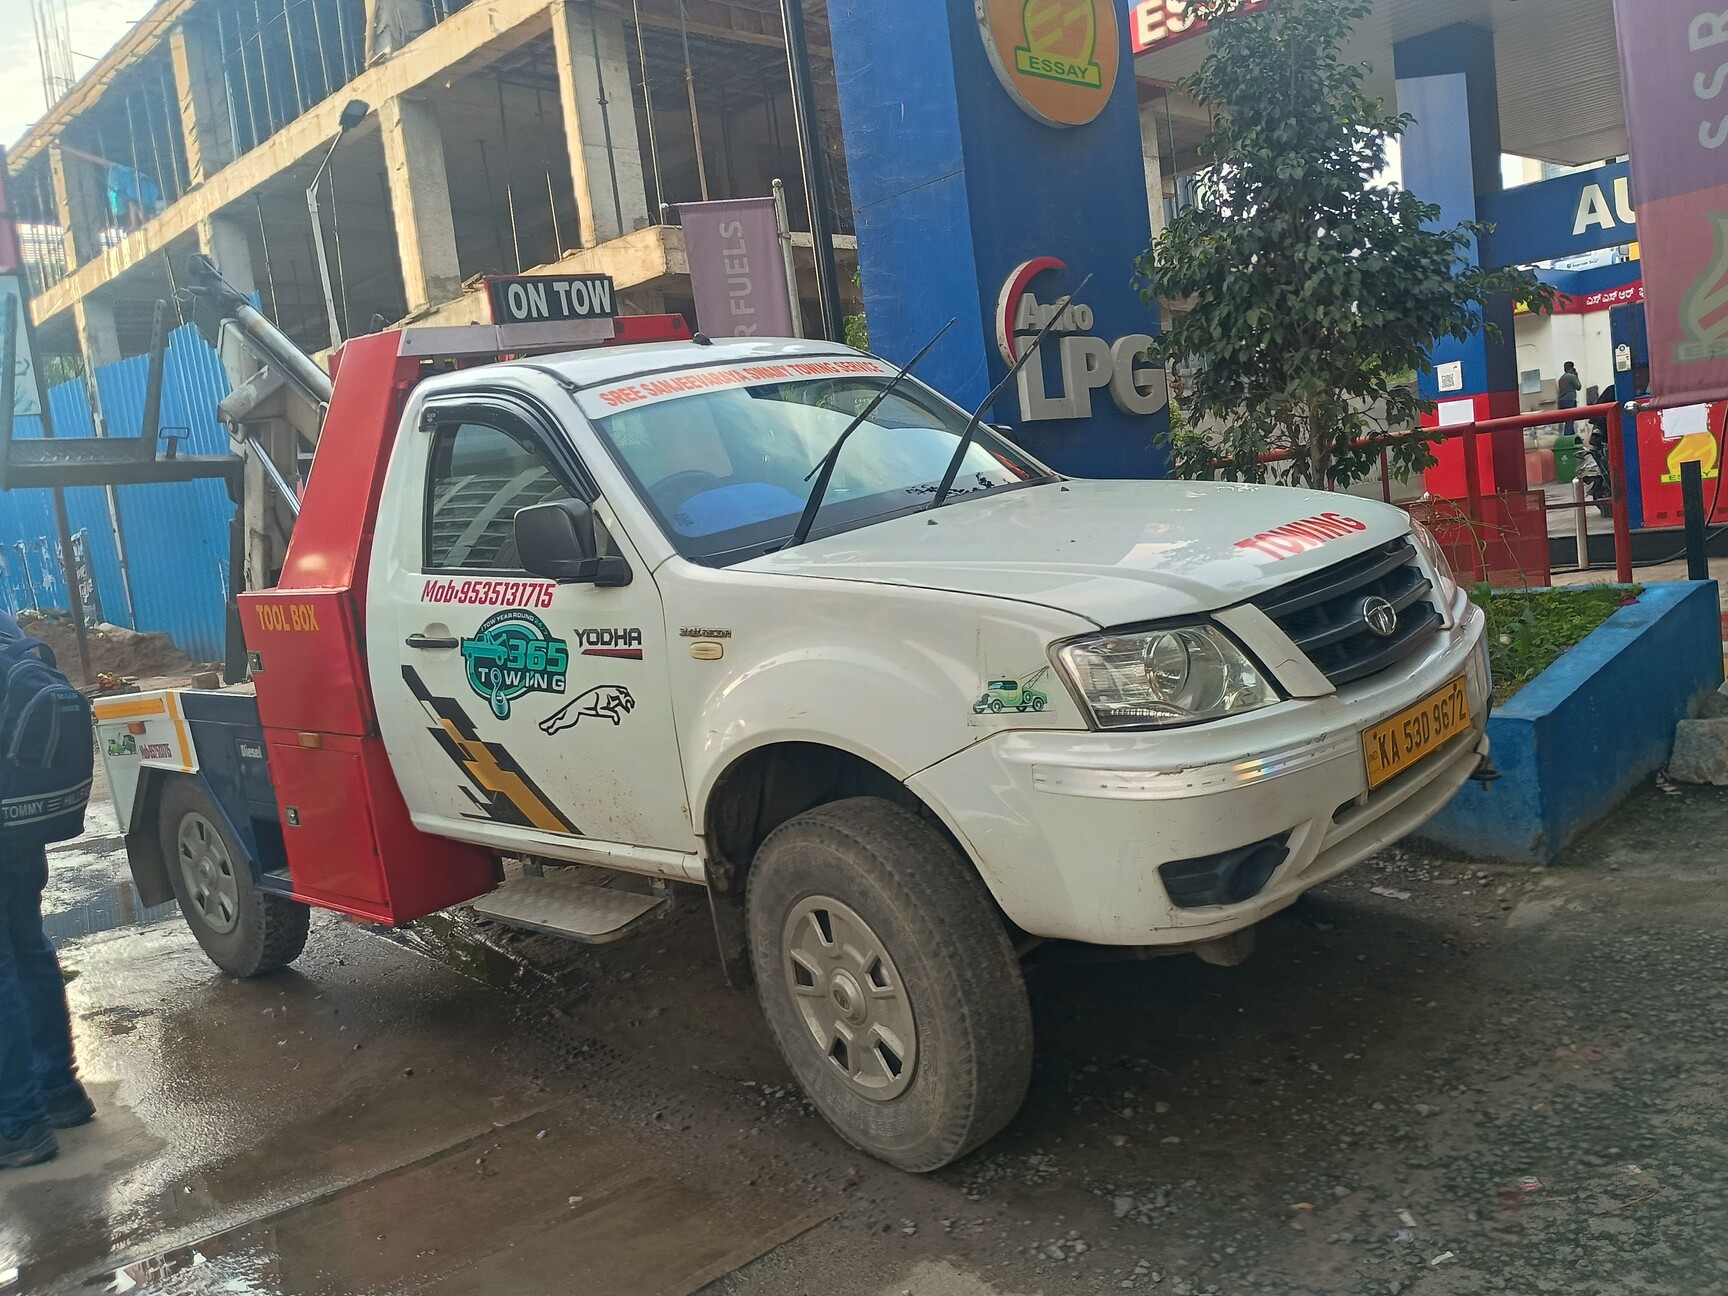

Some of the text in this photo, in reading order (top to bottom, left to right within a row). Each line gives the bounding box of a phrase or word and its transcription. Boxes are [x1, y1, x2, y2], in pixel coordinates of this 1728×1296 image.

[1029, 56, 1088, 80] ESSAY
[720, 221, 755, 315] FUELS
[508, 280, 611, 319] ON TOW
[598, 361, 885, 407] SREE SANJEEVARAYA SWAMY TOWING SERVICE
[1014, 334, 1168, 421] LPG
[1233, 512, 1367, 561] TOWING
[255, 604, 320, 632] TOOL BOX
[483, 617, 497, 630] TOW
[496, 612, 513, 622] YEAR
[512, 611, 535, 622] ROUND
[573, 627, 642, 649] YODHA
[507, 640, 568, 673] 365
[478, 666, 566, 691] TOWING
[1377, 689, 1467, 770] KA 53D 9672
[240, 744, 263, 759] Diesel
[1, 801, 45, 819] TOMMY
